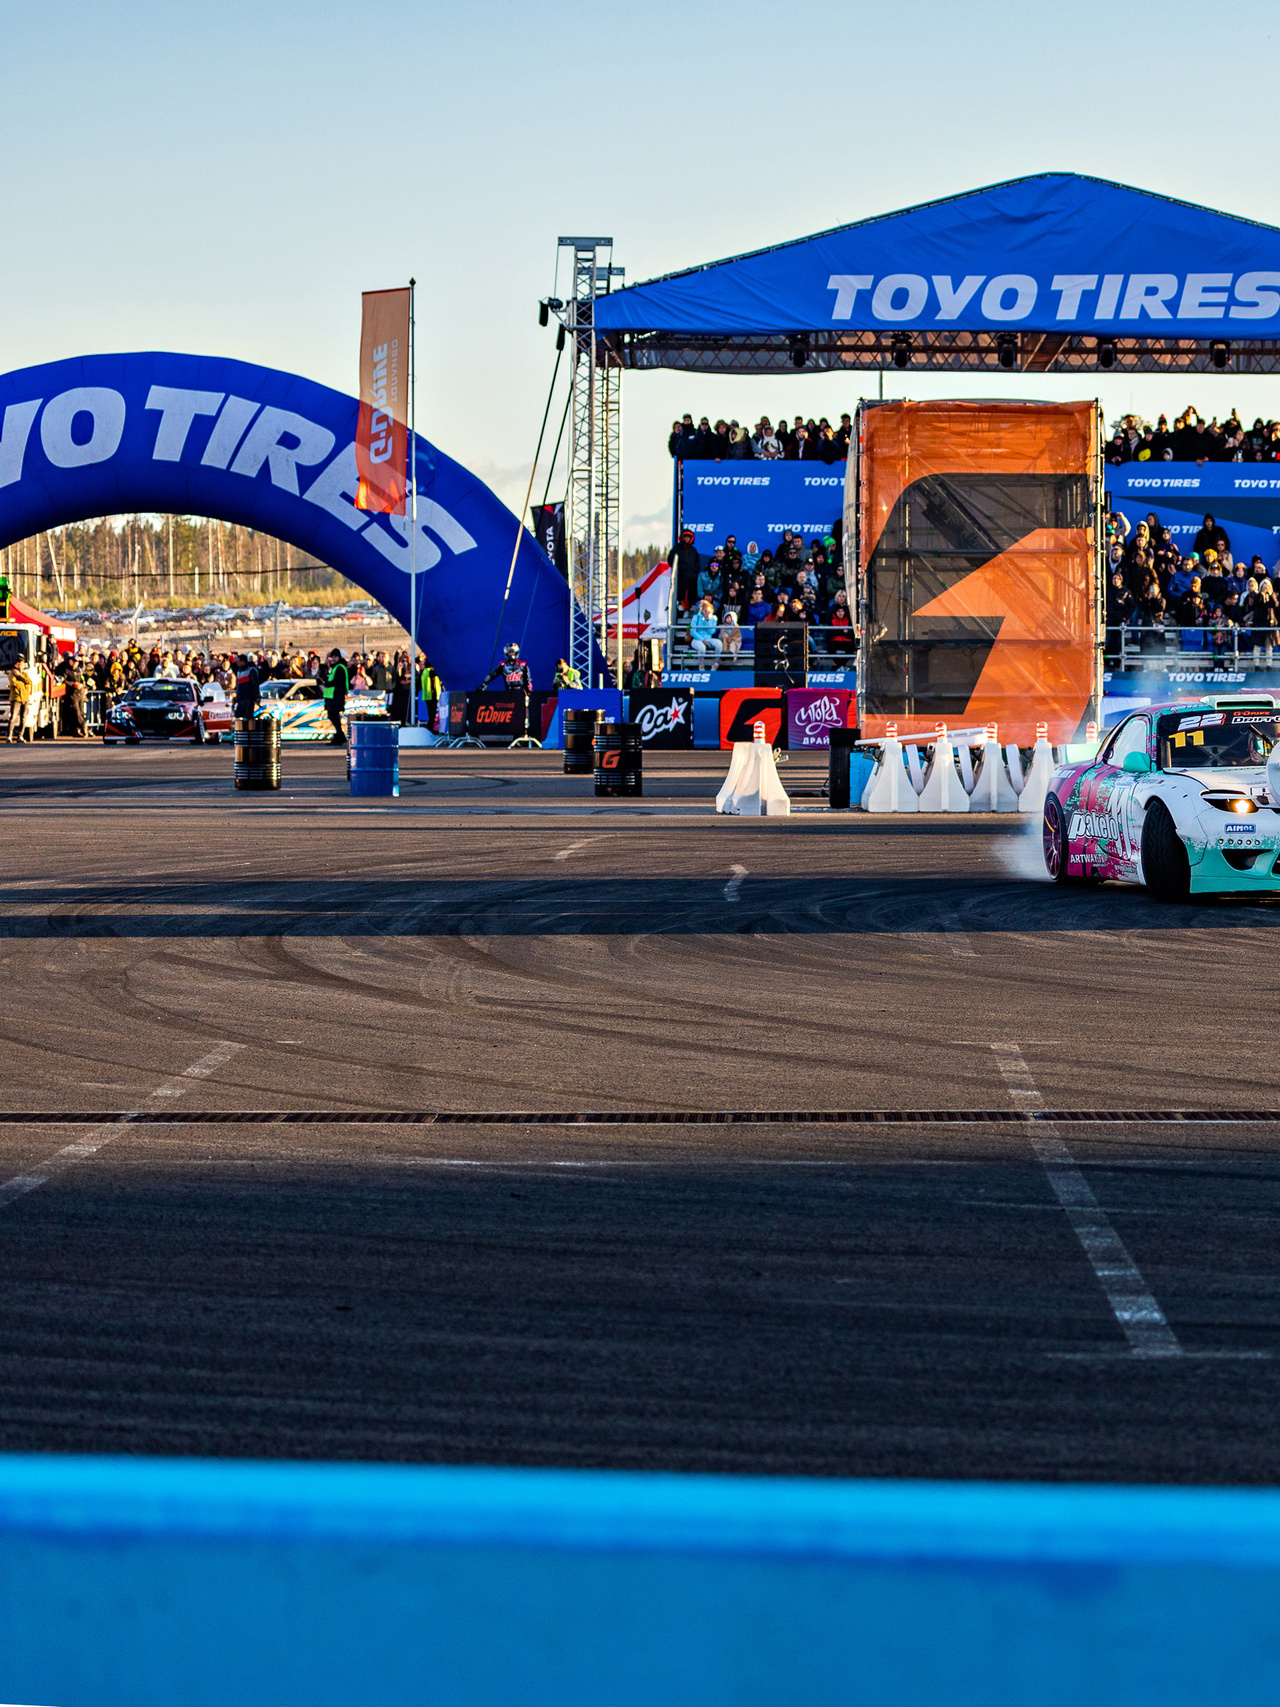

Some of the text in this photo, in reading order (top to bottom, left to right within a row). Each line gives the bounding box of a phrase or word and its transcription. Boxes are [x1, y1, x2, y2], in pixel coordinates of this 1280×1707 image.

[826, 273, 1038, 321] TOYO
[0, 384, 478, 574] YO TIRES
[697, 476, 771, 486] TOYO TIRES
[804, 477, 839, 487] TOYO
[1127, 478, 1201, 488] TOYO TIRES
[1234, 479, 1268, 489] TOYO
[683, 523, 714, 533] IRES
[767, 523, 833, 533] TOYO TIRE
[546, 525, 556, 565] YOTA
[670, 673, 711, 683] TIRES
[807, 673, 845, 683] TIRES
[1168, 672, 1247, 683] TOYO TIRES
[802, 735, 830, 745] ДРАЙ
[1168, 730, 1205, 748] 11
[602, 750, 621, 769] G
[1067, 810, 1119, 842] pakelo
